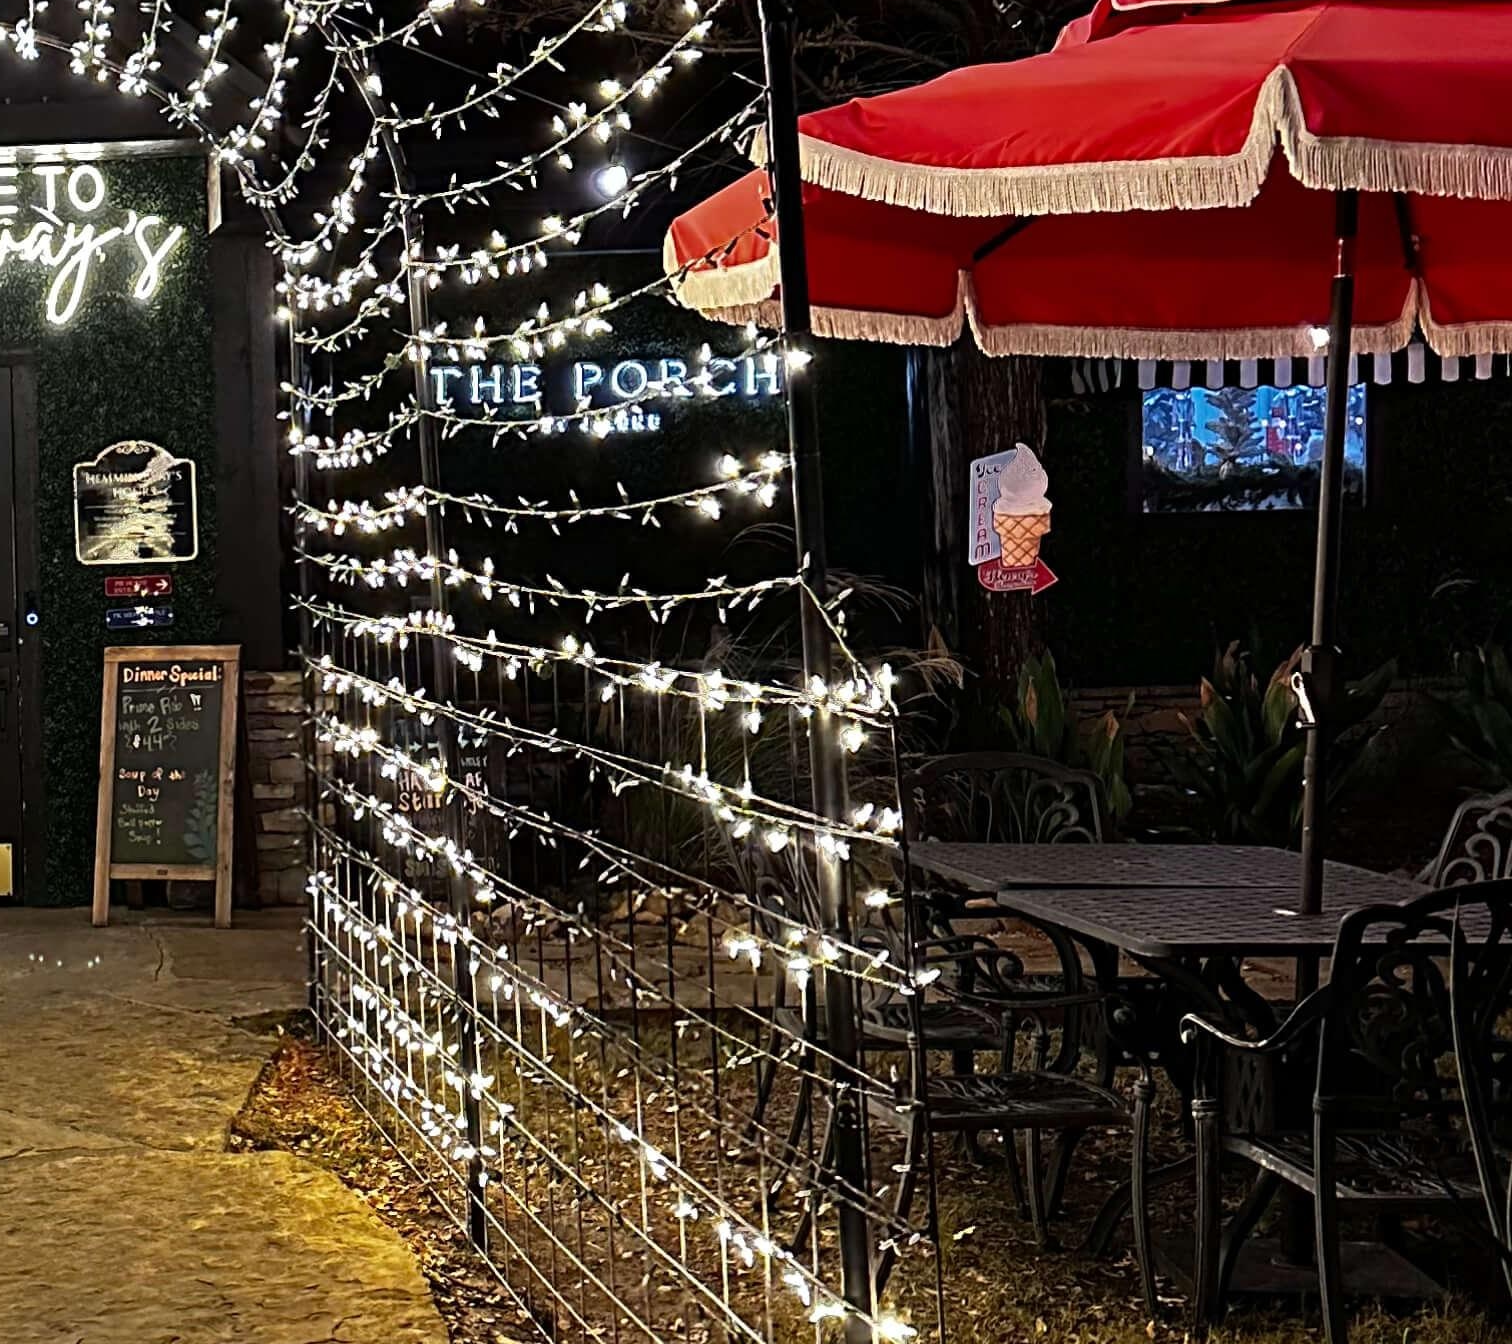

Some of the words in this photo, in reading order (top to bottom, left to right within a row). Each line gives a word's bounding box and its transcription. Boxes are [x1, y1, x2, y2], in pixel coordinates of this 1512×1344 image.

[32, 165, 105, 213] TO
[430, 364, 542, 403] THE
[574, 358, 782, 399] PORCH
[123, 667, 168, 683] Dinner
[147, 716, 163, 734] 2
[118, 768, 146, 782] Soup
[137, 785, 160, 802] Day
